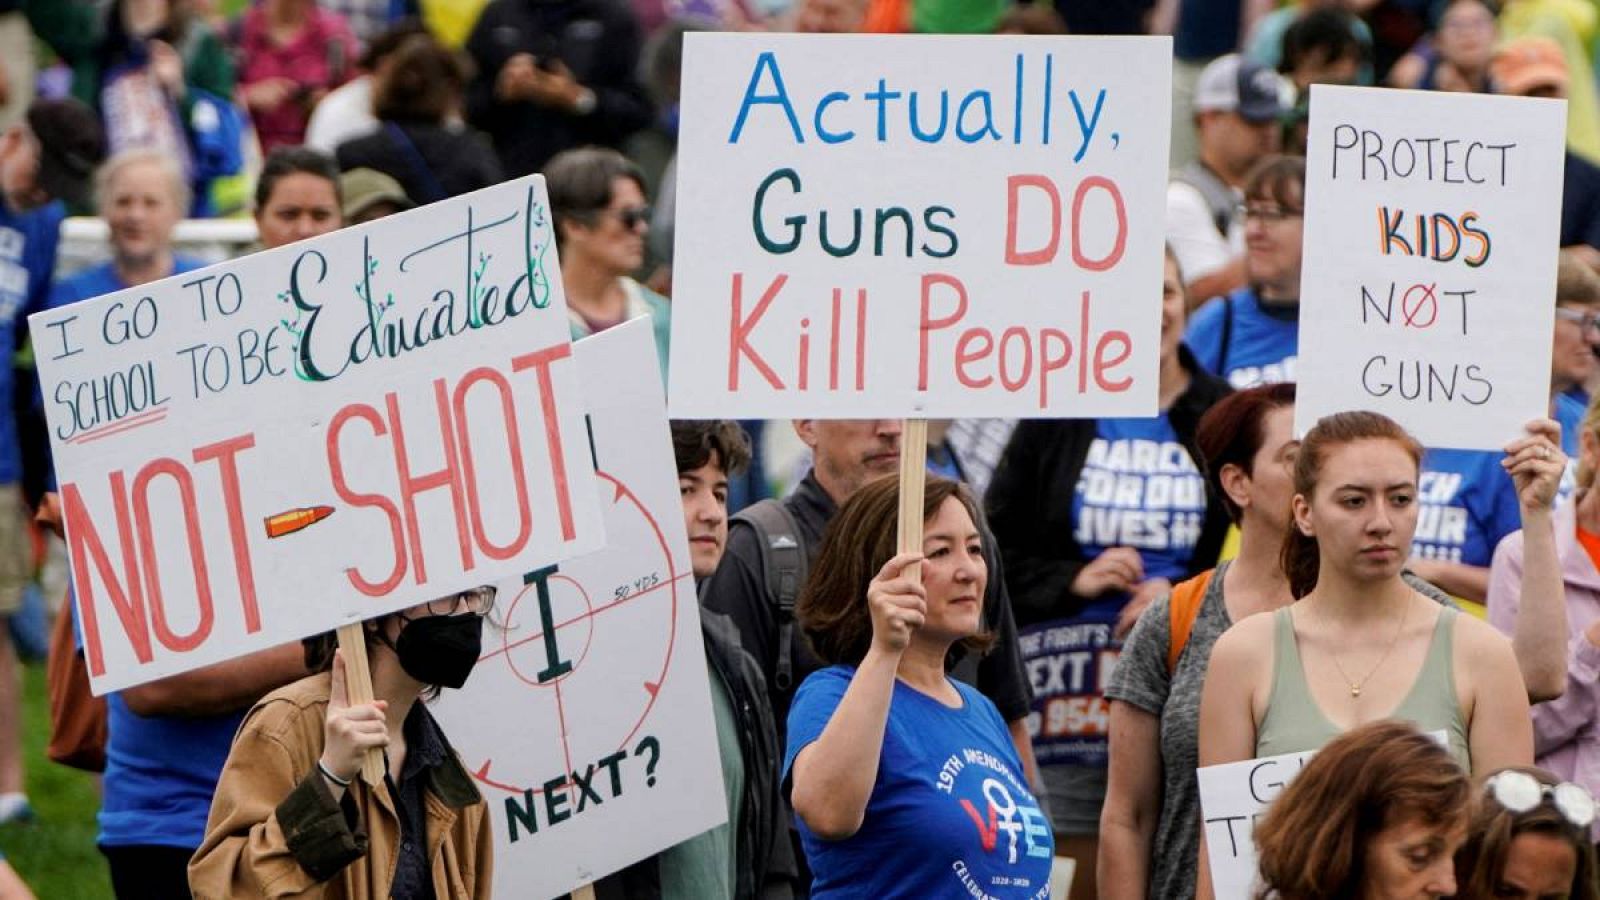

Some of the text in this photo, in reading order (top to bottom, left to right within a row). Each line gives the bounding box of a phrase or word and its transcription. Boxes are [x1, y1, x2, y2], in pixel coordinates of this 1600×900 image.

[727, 51, 1121, 163] Actually,
[1332, 124, 1517, 186] PROTECT
[752, 167, 1128, 271] Guns DO
[1377, 205, 1492, 268] KIDS
[46, 272, 243, 361] I GO TO
[54, 185, 545, 441] SCHOOL TO BE Educated
[727, 272, 1134, 408] Kill People
[1362, 355, 1493, 405] GUNS
[61, 342, 577, 678] NOT SHOT
[523, 563, 573, 684] I
[634, 571, 659, 591] YDS
[504, 736, 661, 844] NEXT?
[936, 754, 965, 795] 19TH
